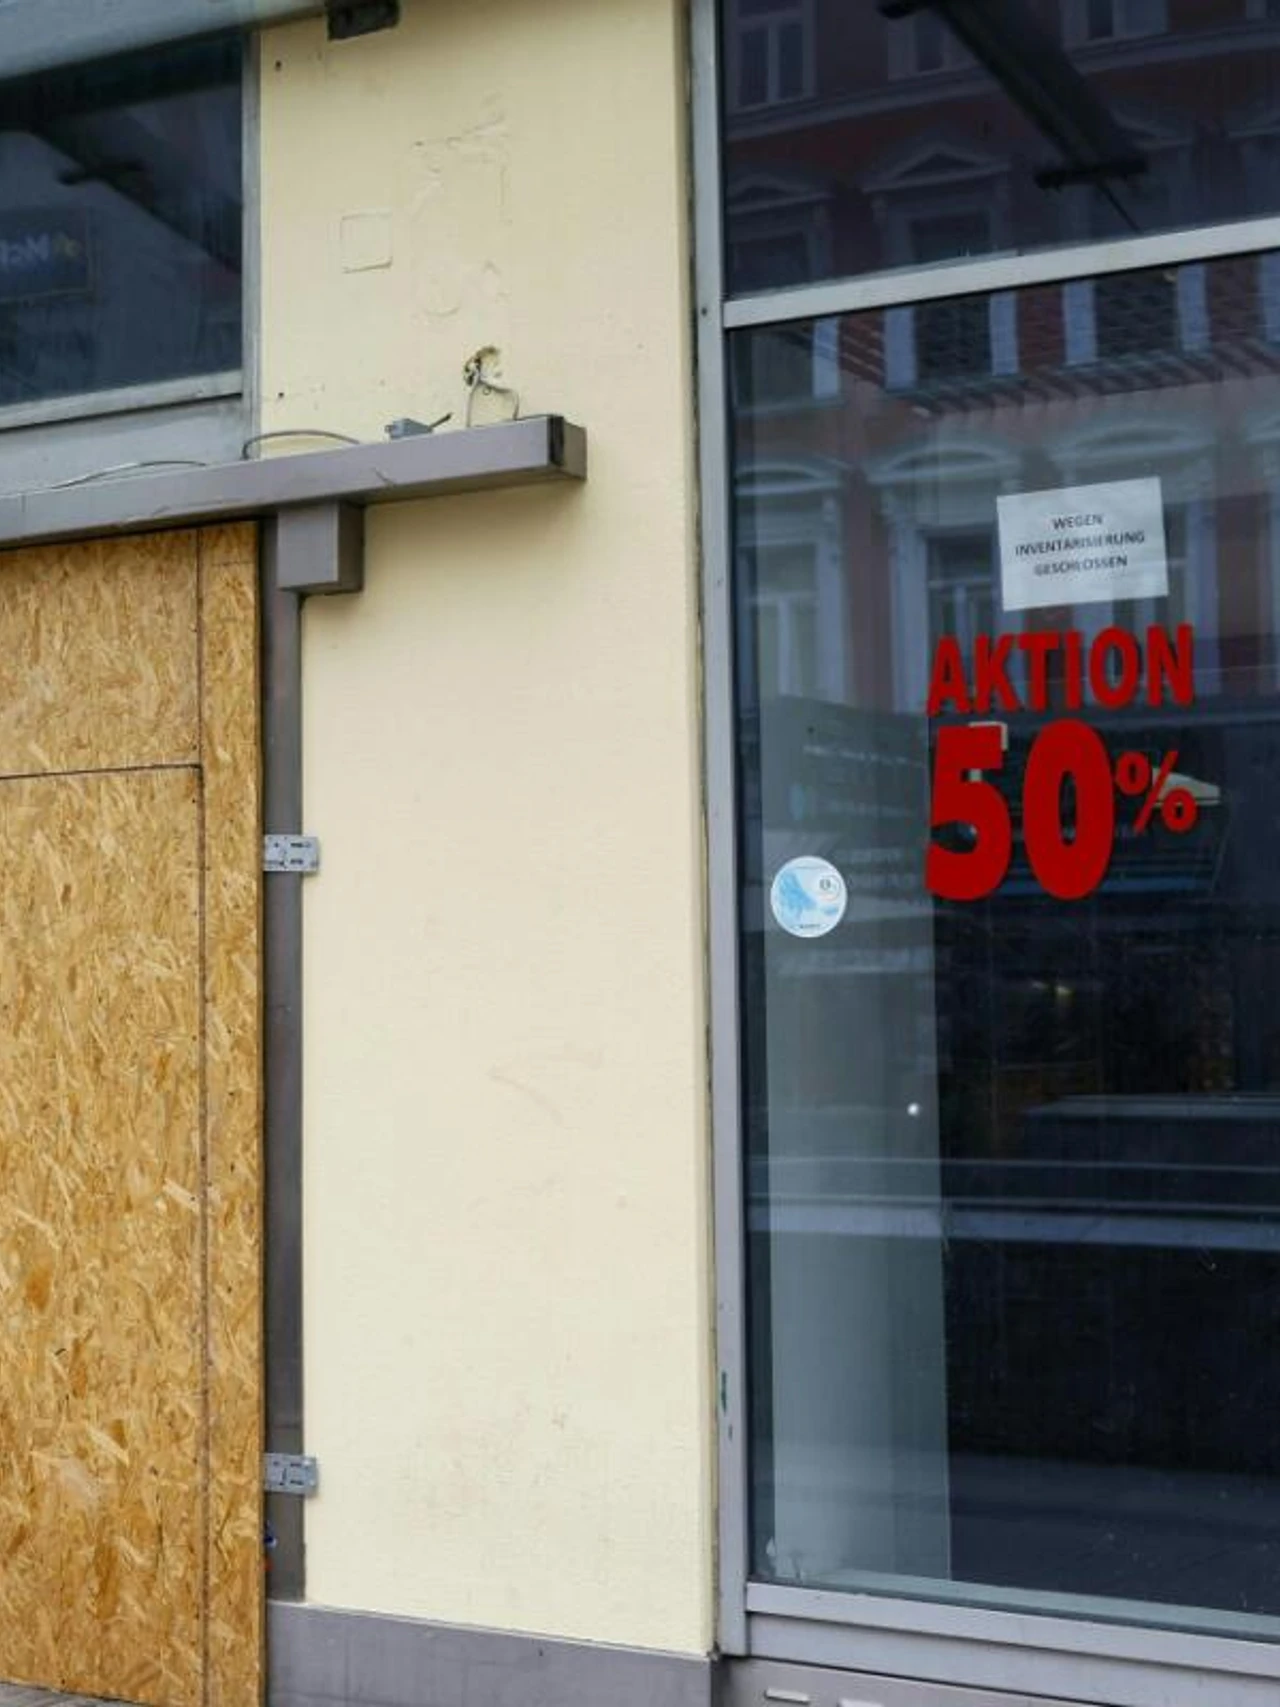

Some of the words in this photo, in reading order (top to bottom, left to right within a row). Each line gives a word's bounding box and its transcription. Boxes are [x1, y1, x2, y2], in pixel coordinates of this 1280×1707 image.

[1053, 514, 1103, 529] WEGEN
[1016, 531, 1145, 555] INVENTARISIERUNG
[1035, 556, 1127, 576] GESCHLOSSEN
[926, 622, 1194, 716] AKTION
[925, 718, 1198, 902] 50%
